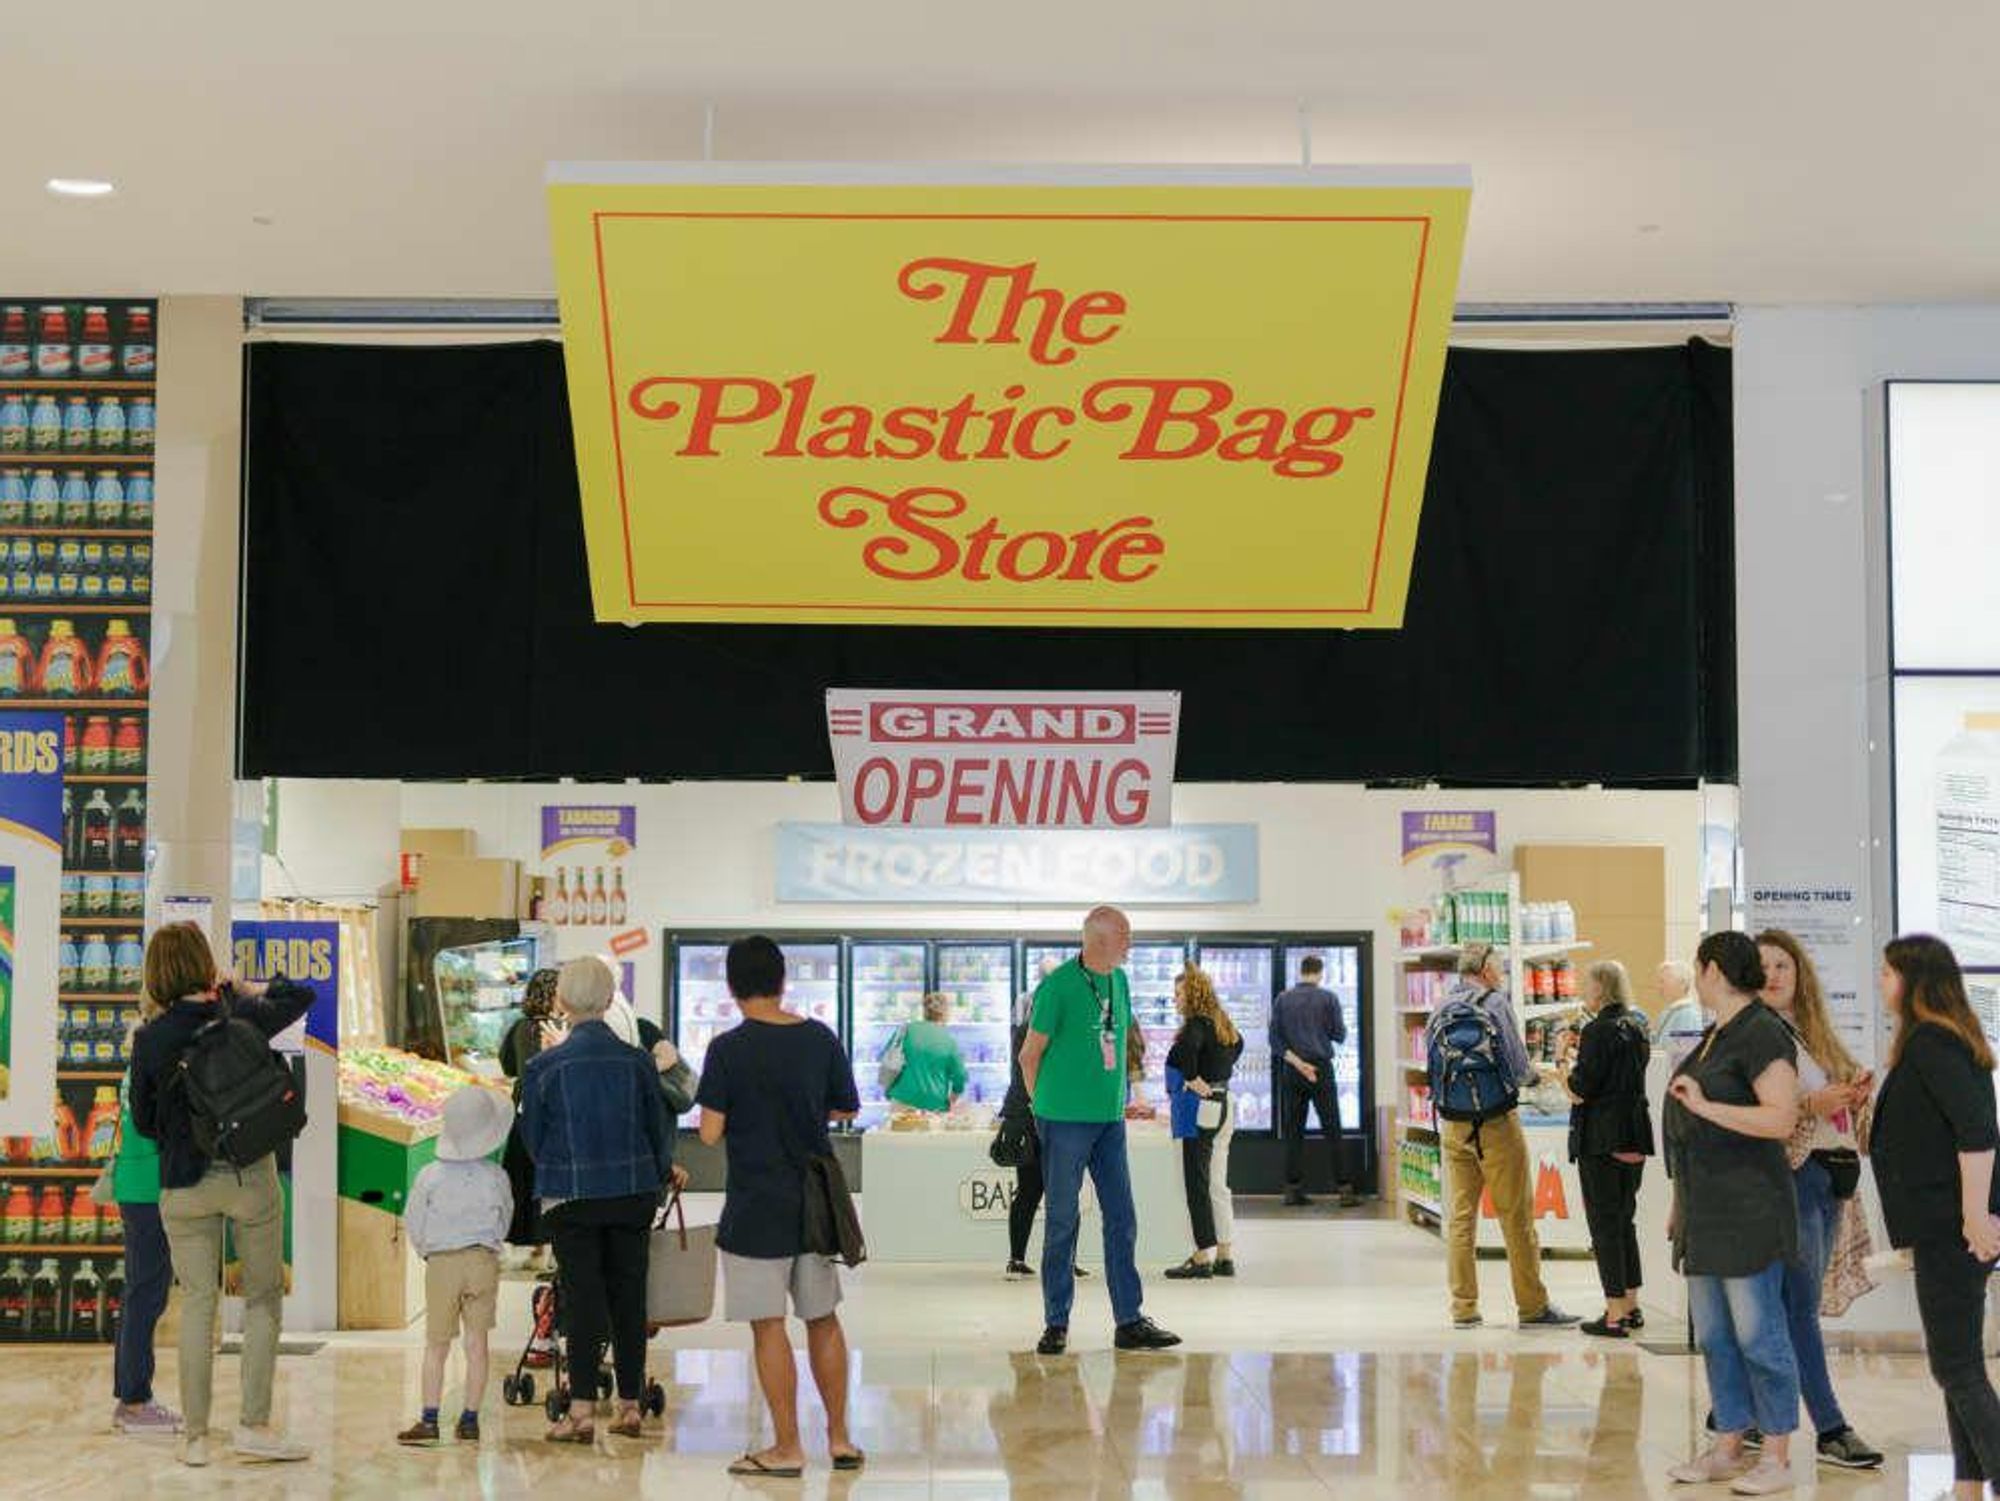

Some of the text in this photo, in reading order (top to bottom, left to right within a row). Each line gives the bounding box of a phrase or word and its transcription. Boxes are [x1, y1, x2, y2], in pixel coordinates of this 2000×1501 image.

[896, 256, 1128, 367] The
[628, 373, 1376, 480] Plastic Bag
[818, 485, 1167, 584] Store
[880, 706, 1127, 738] GRAND
[853, 756, 1151, 825] OPENING
[811, 841, 1228, 889] FROZEN FOOD
[1753, 890, 1852, 902] OPENING TIMES
[971, 1179, 1020, 1210] BAK
